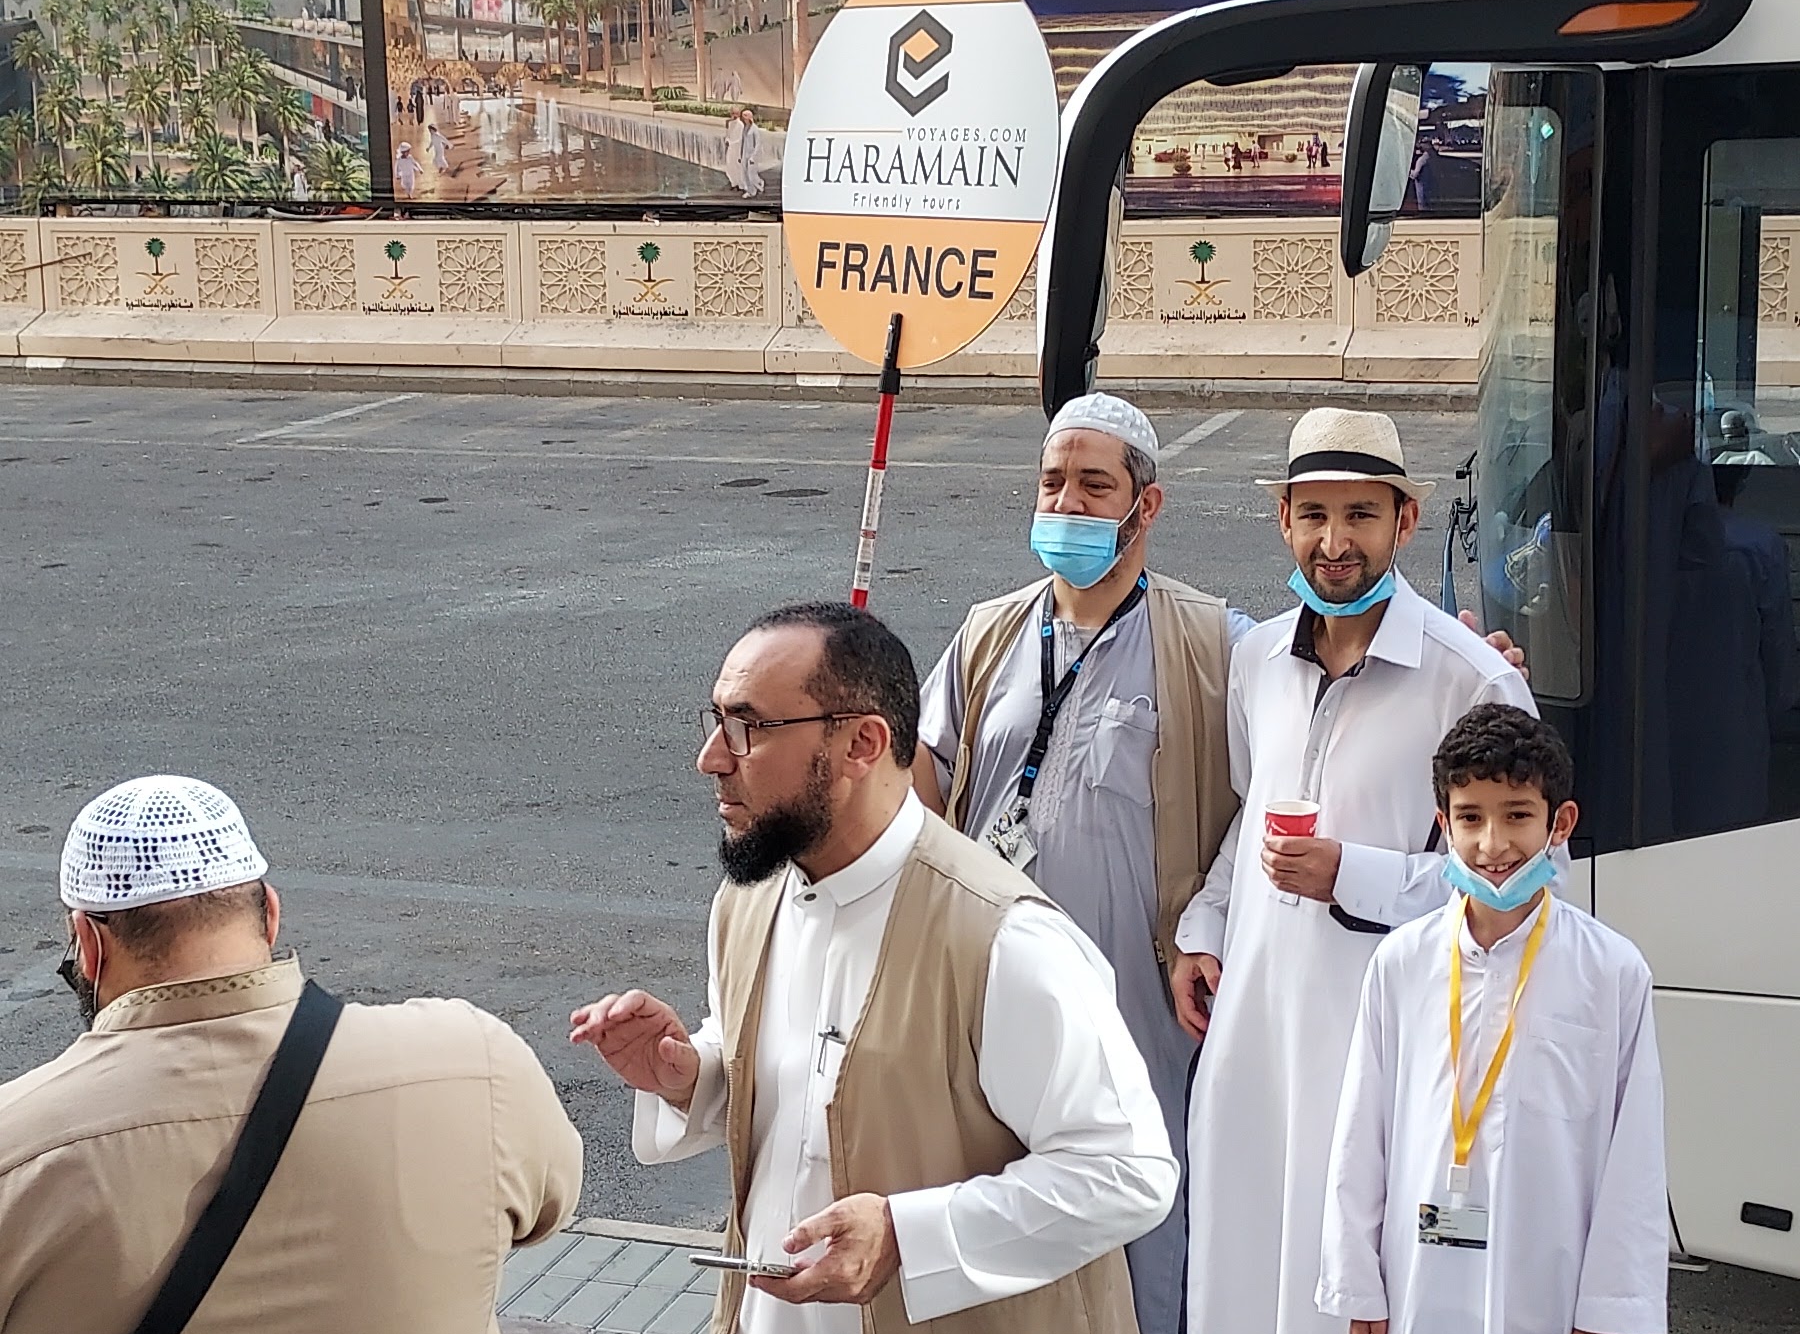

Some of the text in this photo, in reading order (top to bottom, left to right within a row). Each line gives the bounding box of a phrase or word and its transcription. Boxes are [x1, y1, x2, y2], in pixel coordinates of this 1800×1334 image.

[906, 127, 1027, 143] VOYAGES.COM
[803, 137, 1024, 188] HARAMAIN
[852, 192, 961, 212] Friendly tours
[816, 241, 998, 301] FRANCE
[1160, 307, 1247, 324] هيئة تطوير المدينة المنورة
